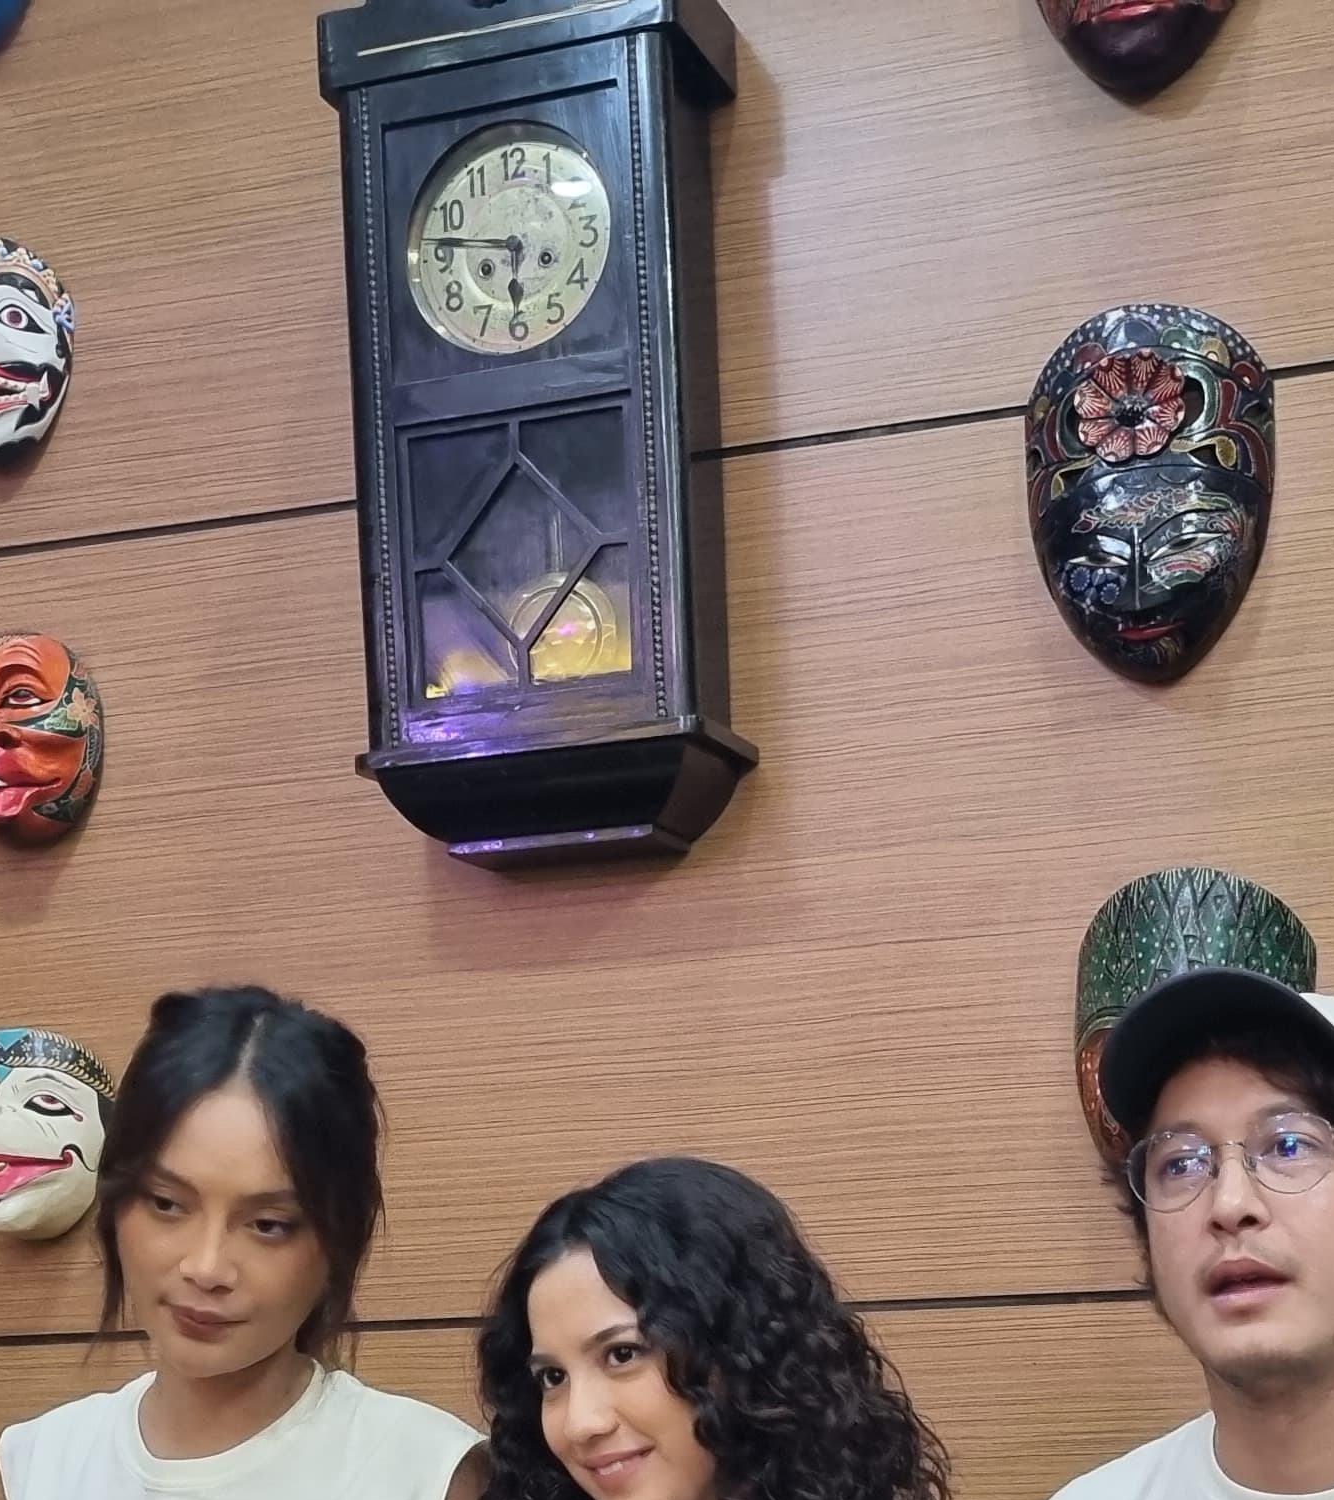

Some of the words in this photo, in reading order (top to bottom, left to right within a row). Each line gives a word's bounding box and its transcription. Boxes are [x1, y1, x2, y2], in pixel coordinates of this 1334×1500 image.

[500, 147, 526, 181] 12
[542, 151, 552, 184] 1
[467, 164, 486, 198] 11
[439, 199, 464, 233] 10
[579, 214, 599, 248] 3
[566, 257, 589, 290] 4
[445, 280, 464, 312] 8
[546, 292, 565, 325] 5
[473, 303, 493, 337] 7
[508, 309, 529, 342] 6
